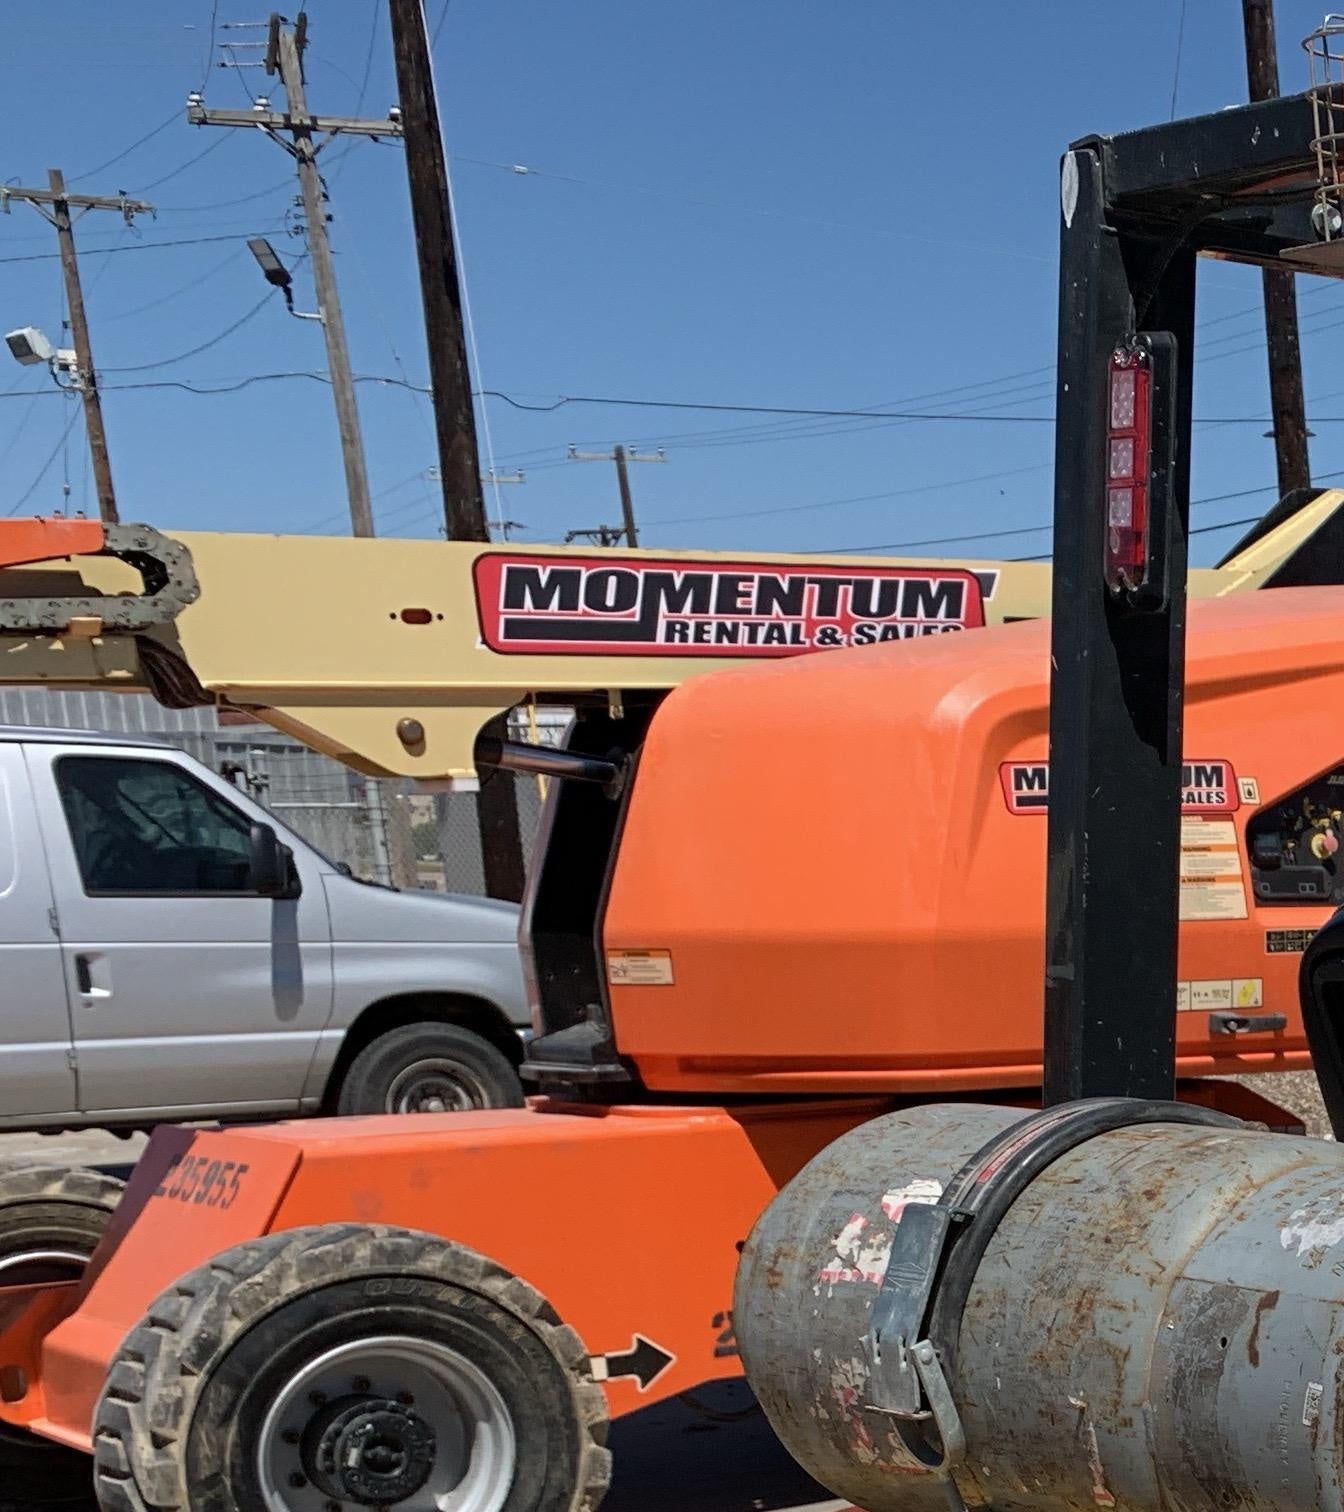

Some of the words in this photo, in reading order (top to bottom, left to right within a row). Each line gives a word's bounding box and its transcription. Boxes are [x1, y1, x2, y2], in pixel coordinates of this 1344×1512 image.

[502, 565, 967, 620] MOMENTUM
[662, 620, 807, 646] RENTAL
[815, 622, 845, 647] &
[1181, 791, 1226, 804] ALES
